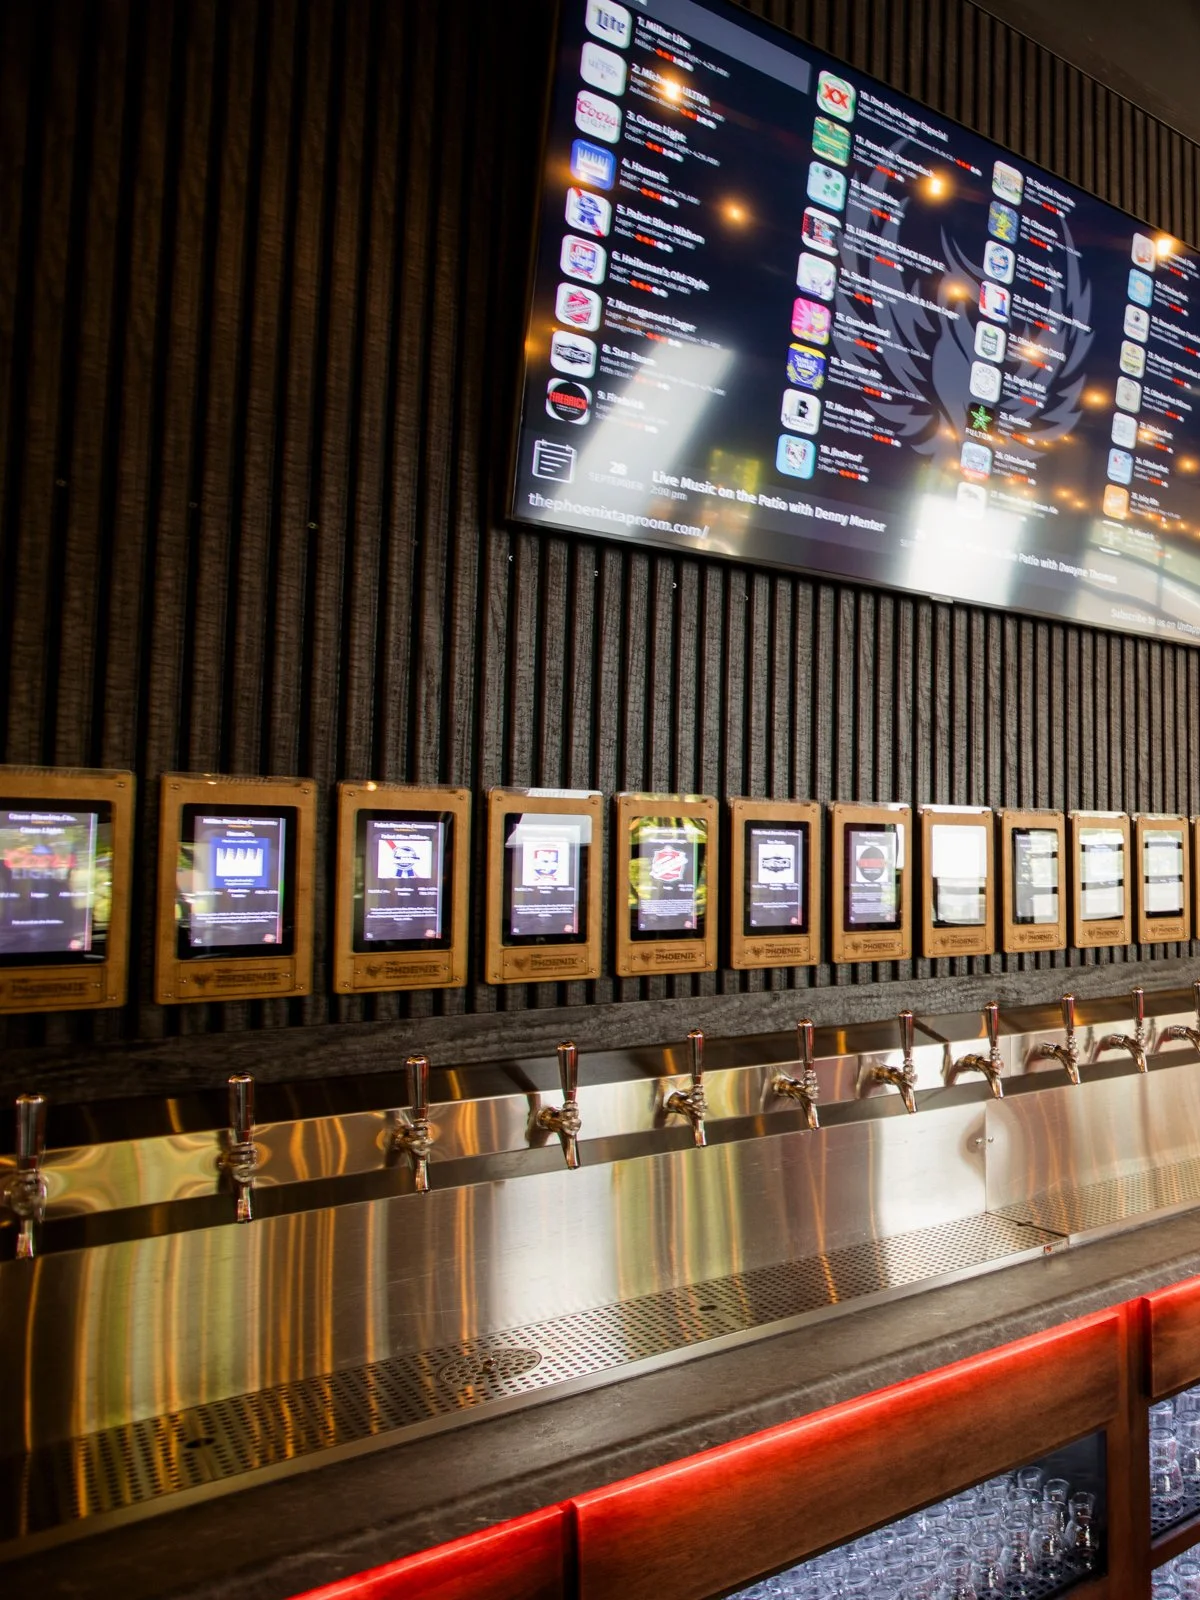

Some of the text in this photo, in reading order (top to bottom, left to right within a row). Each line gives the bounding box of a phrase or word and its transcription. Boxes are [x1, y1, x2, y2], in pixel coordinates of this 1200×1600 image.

[595, 7, 626, 39] Lite
[644, 18, 672, 41] Miller
[671, 32, 691, 50] Lite
[682, 85, 711, 108] ULTRA
[575, 96, 619, 129] Coors
[869, 94, 884, 110] Dos
[902, 111, 920, 129] Lager
[920, 121, 948, 143] Especial
[635, 112, 662, 134] Coors
[661, 124, 687, 145] Light
[864, 138, 894, 161] Armchair
[630, 160, 669, 184] Hamm's
[860, 182, 899, 208] Waterslides
[625, 206, 652, 225] Pabst
[651, 216, 672, 233] Blue
[673, 224, 705, 245] Ribbon
[621, 253, 670, 280] Heileman's
[670, 270, 687, 285] Old
[685, 275, 709, 293] Style
[850, 271, 870, 287] Stone
[904, 292, 918, 306] Salt
[925, 300, 941, 315] Lime
[941, 307, 960, 322] Lager
[615, 299, 672, 327] Narragansett
[671, 318, 696, 335] Lager
[611, 346, 630, 360] Sun
[630, 351, 656, 368] Beam
[840, 359, 867, 376] Summer
[867, 368, 882, 381] Ale
[548, 390, 587, 410] FIREBRICK
[834, 402, 854, 418] Moon
[853, 408, 875, 424] Ridge
[964, 427, 993, 442] FULTON
[651, 468, 886, 533] Live Music on the Patio with Denny Menter
[670, 490, 688, 503] pm
[527, 489, 709, 540] thephoenixtaproom.com/
[1018, 552, 1039, 567] Patio
[1040, 557, 1058, 571] with
[1058, 561, 1088, 579] Dwayne
[386, 966, 440, 974] PHOENIX
[531, 958, 577, 967] PHOENIX
